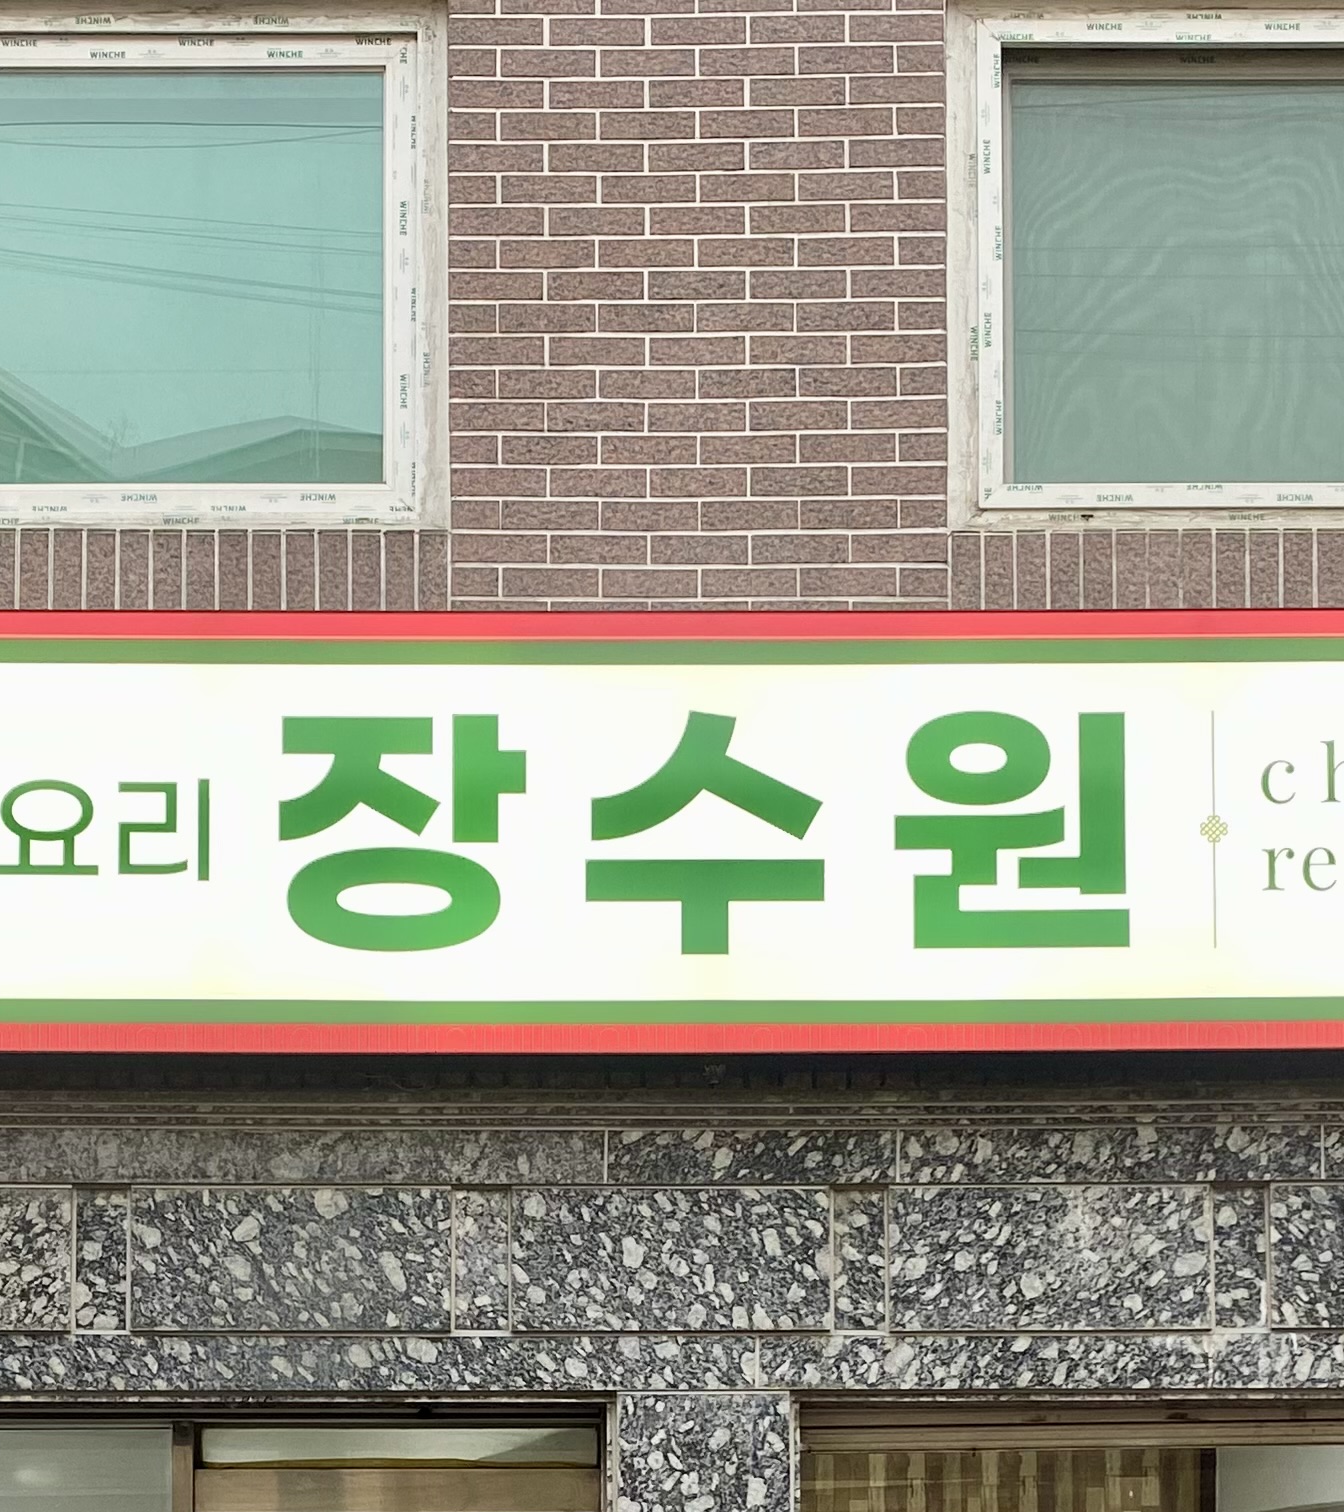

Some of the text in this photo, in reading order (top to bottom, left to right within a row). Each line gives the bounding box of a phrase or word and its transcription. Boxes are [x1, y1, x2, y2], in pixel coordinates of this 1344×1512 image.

[75, 16, 112, 24] WINCHE
[1086, 22, 1122, 30] WINCHE
[1265, 22, 1300, 30] WINCHE
[1, 39, 37, 47] WINCHE
[356, 38, 392, 46] WINCHE
[267, 50, 302, 58] WINCHE
[984, 312, 992, 348] WINCHE
[970, 326, 978, 361] WINCHE
[400, 374, 408, 409] WINCHE
[121, 494, 157, 502] WINCHE
[300, 494, 336, 502] WINCHE
[1097, 494, 1134, 502] WINCHE
[1277, 494, 1313, 502] WINCHE
[277, 710, 1131, 955] 장수원
